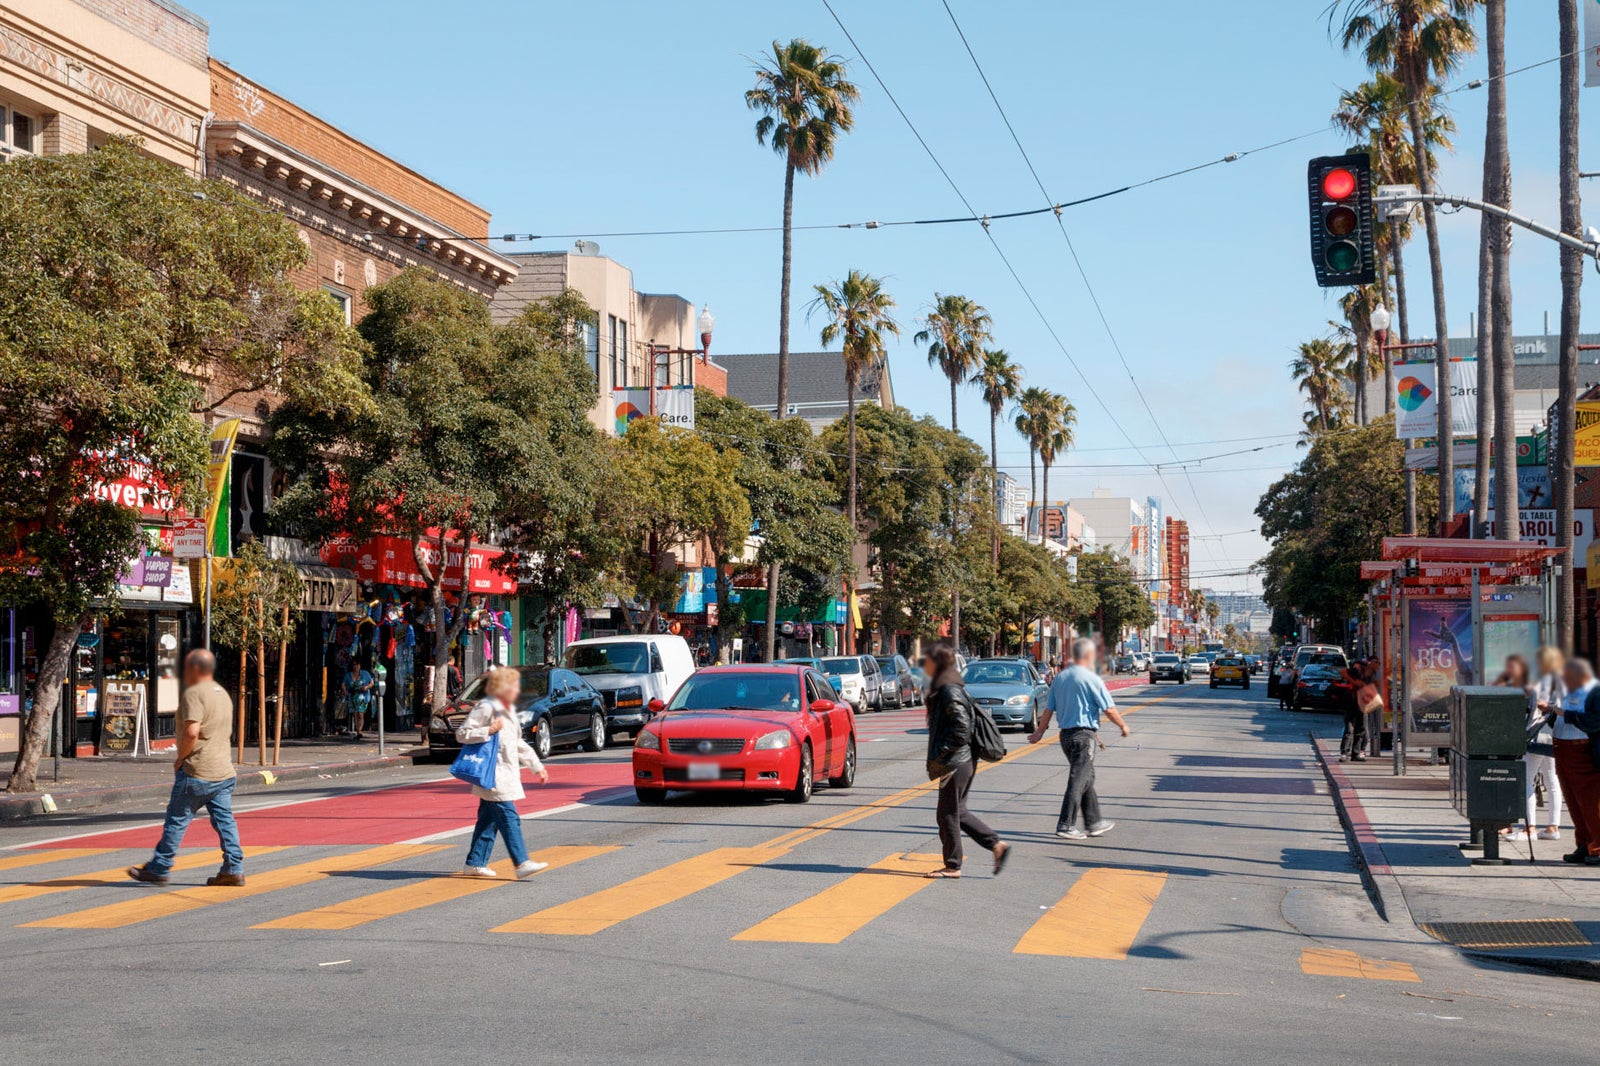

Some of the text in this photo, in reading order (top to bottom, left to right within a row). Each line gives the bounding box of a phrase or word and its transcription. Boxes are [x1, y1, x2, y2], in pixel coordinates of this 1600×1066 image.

[1514, 340, 1548, 354] ank
[660, 412, 692, 423] Care.
[1531, 511, 1553, 519] TABLE
[145, 560, 169, 571] VAPOR
[1443, 568, 1467, 577] RAPID
[1507, 567, 1531, 576] RAPID
[145, 573, 166, 583] SHOP
[1456, 586, 1472, 595] RAP
[1417, 647, 1452, 669] BFG
